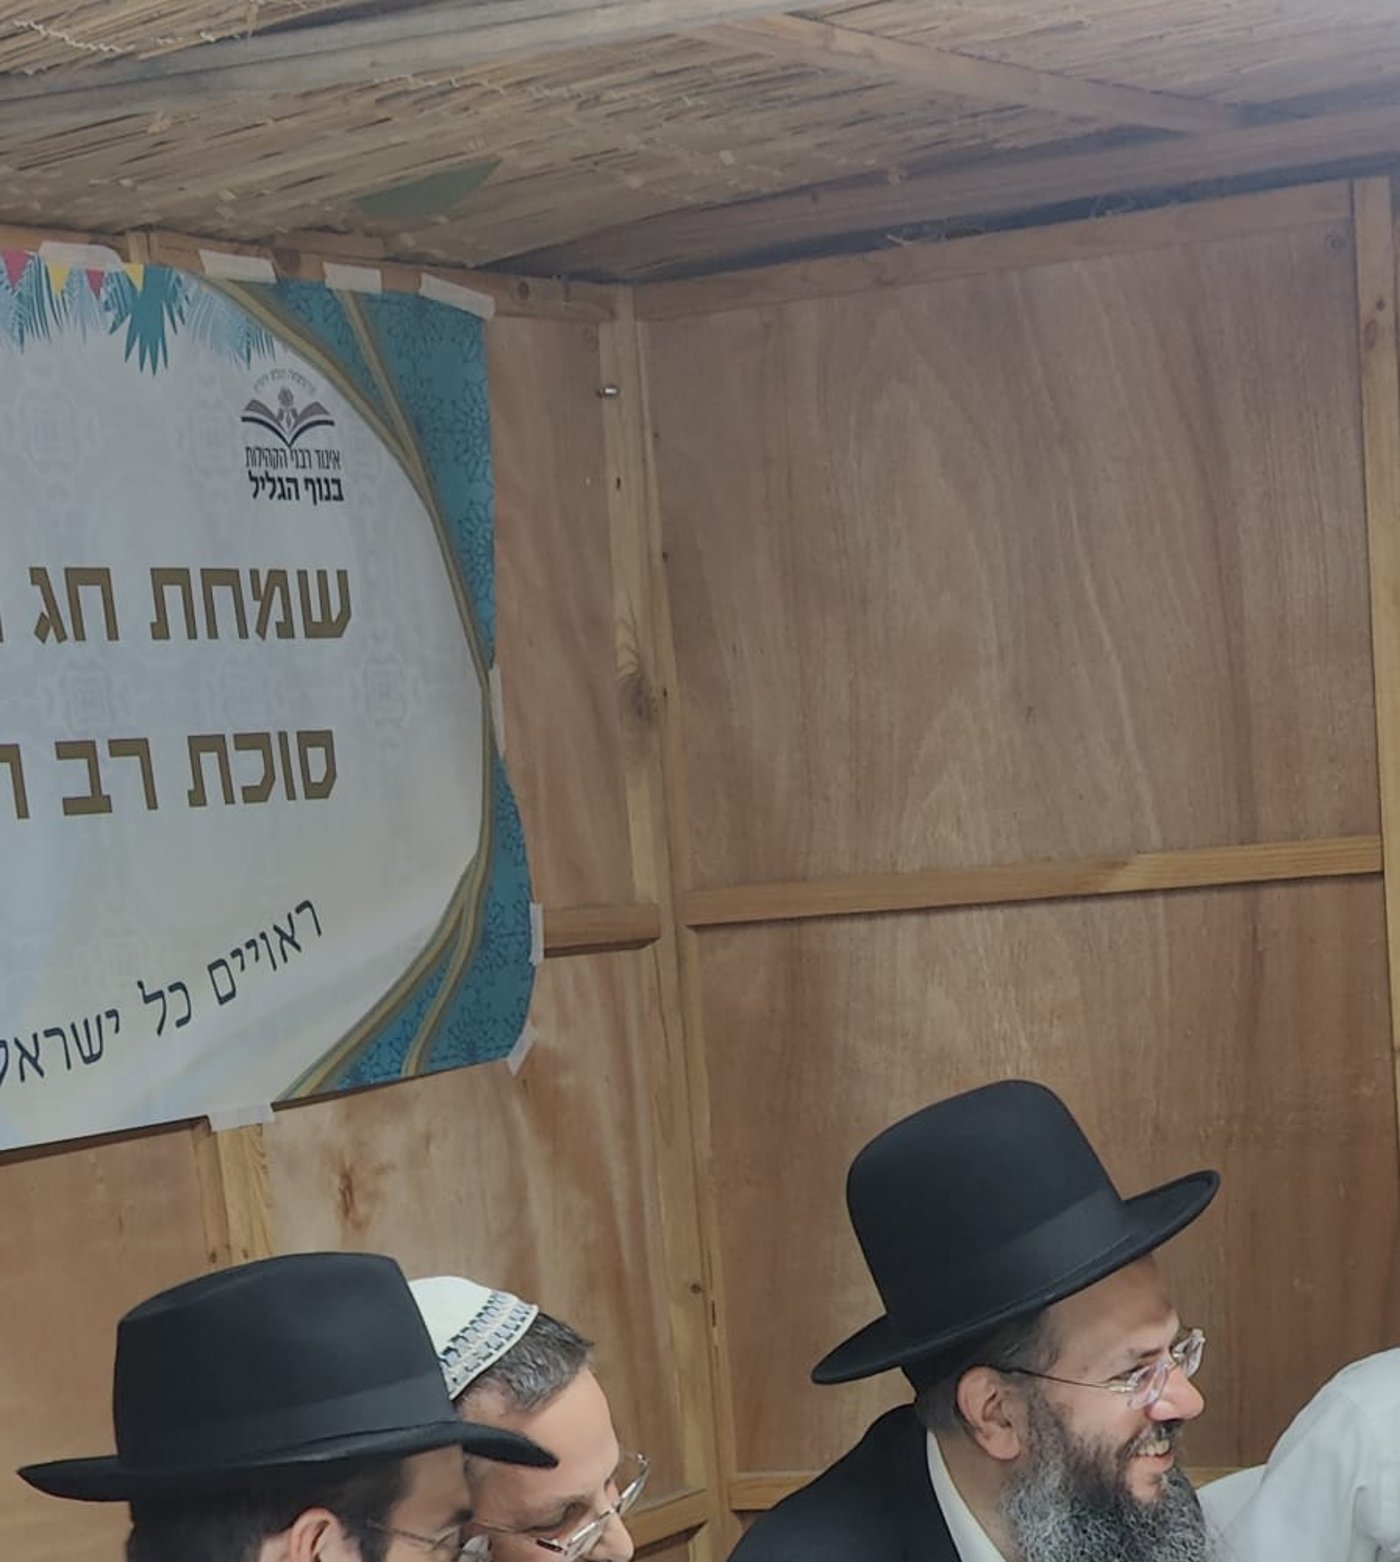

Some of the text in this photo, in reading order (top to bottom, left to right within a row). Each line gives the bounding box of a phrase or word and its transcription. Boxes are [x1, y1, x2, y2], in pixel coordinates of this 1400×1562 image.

[247, 469, 344, 506] בנוף הגליל
[29, 566, 352, 644] שמחת חג
[54, 738, 159, 817] רב
[187, 730, 338, 808] סוכת
[207, 900, 322, 1006] ראויים
[137, 980, 192, 1036] כל
